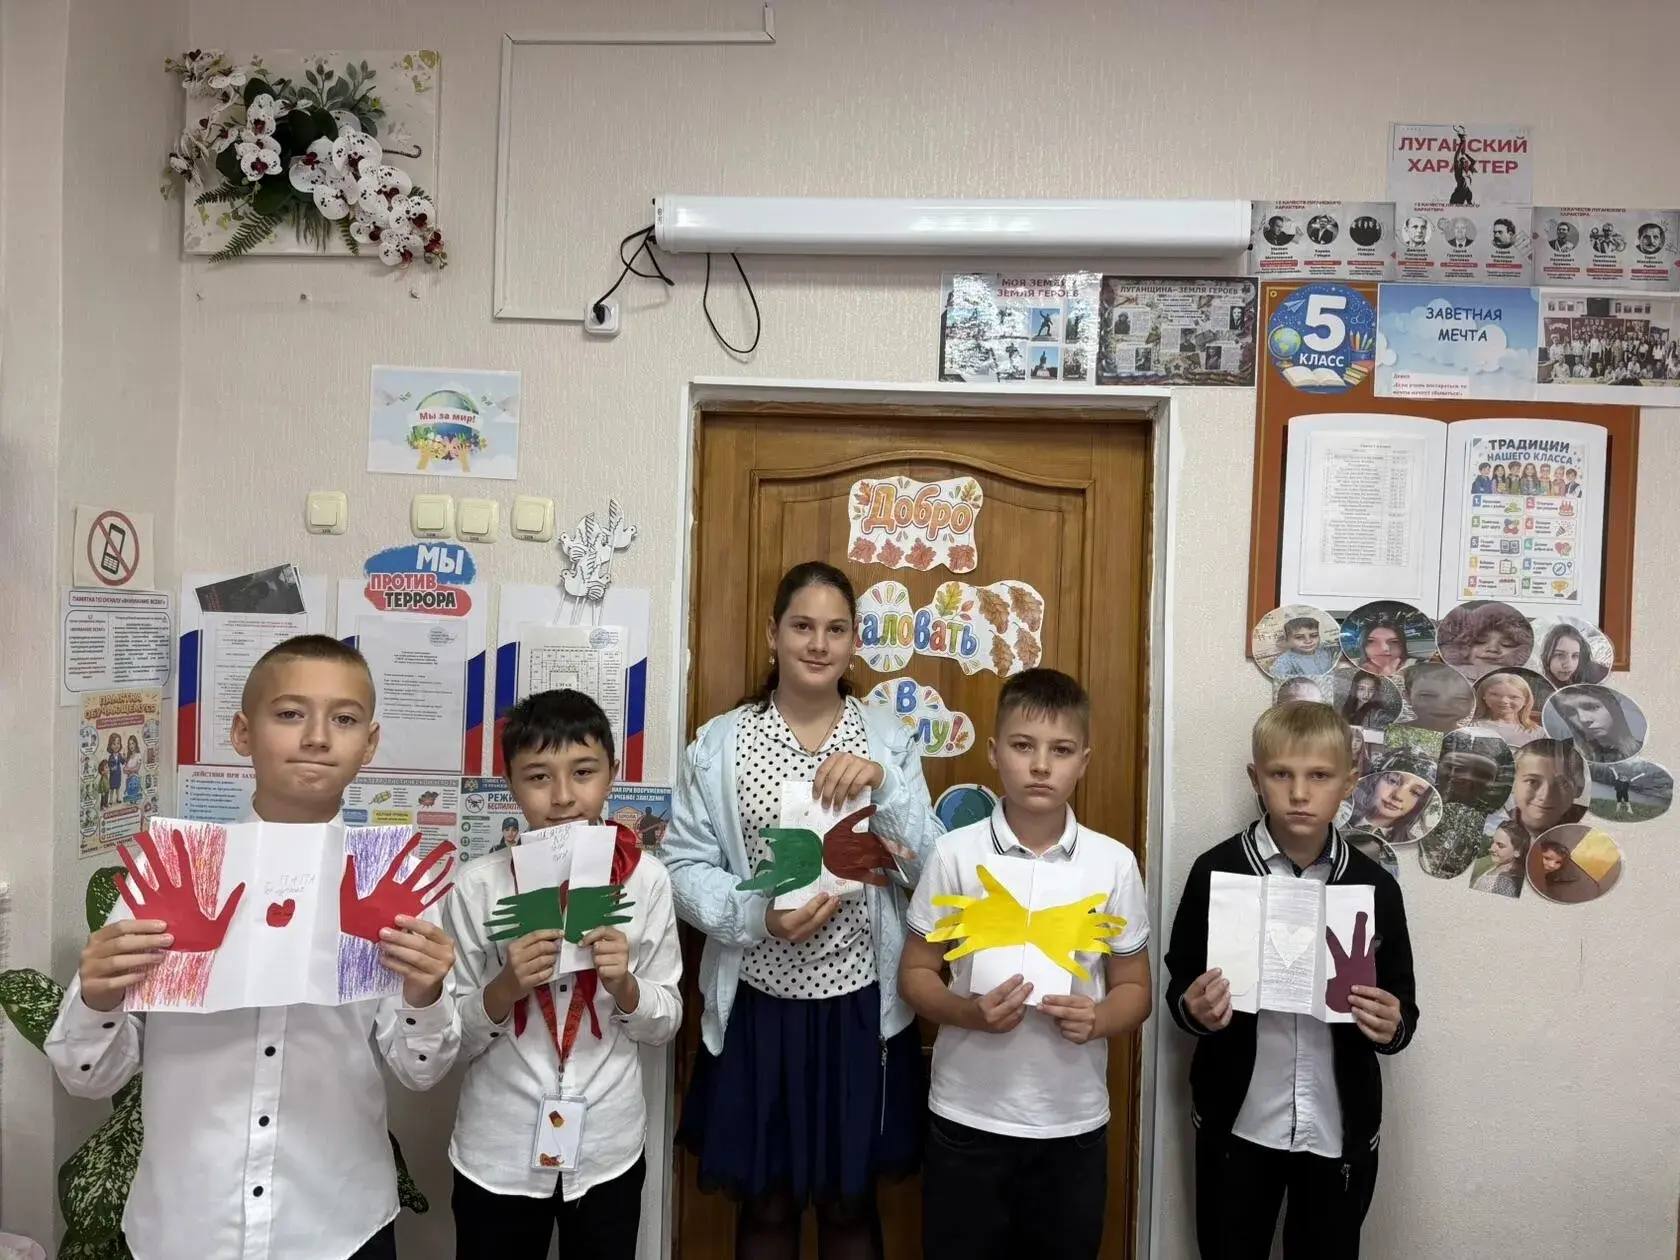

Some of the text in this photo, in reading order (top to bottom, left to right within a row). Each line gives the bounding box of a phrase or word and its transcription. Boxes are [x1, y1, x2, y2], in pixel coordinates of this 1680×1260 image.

[1399, 136, 1527, 153] ЛУГАНСКИЙ
[1001, 278, 1026, 287] МОЯ
[1425, 307, 1503, 321] ЗАВЕТНАЯ
[1303, 294, 1347, 352] 5
[1438, 328, 1488, 342] МЕЧТА
[1299, 353, 1345, 367] КЛАСС
[419, 411, 436, 420] Мы
[452, 413, 476, 424] мир!
[1488, 439, 1570, 453] ТРАДИЦИИ
[1487, 452, 1573, 465] НАШЕГО КЛАССА
[862, 483, 974, 541] Добро
[415, 544, 465, 575] МЫ
[370, 573, 437, 590] ПРОТИВ
[384, 591, 456, 608] ТЕРРОРА
[856, 608, 980, 657] аловать
[901, 712, 964, 755] лу!
